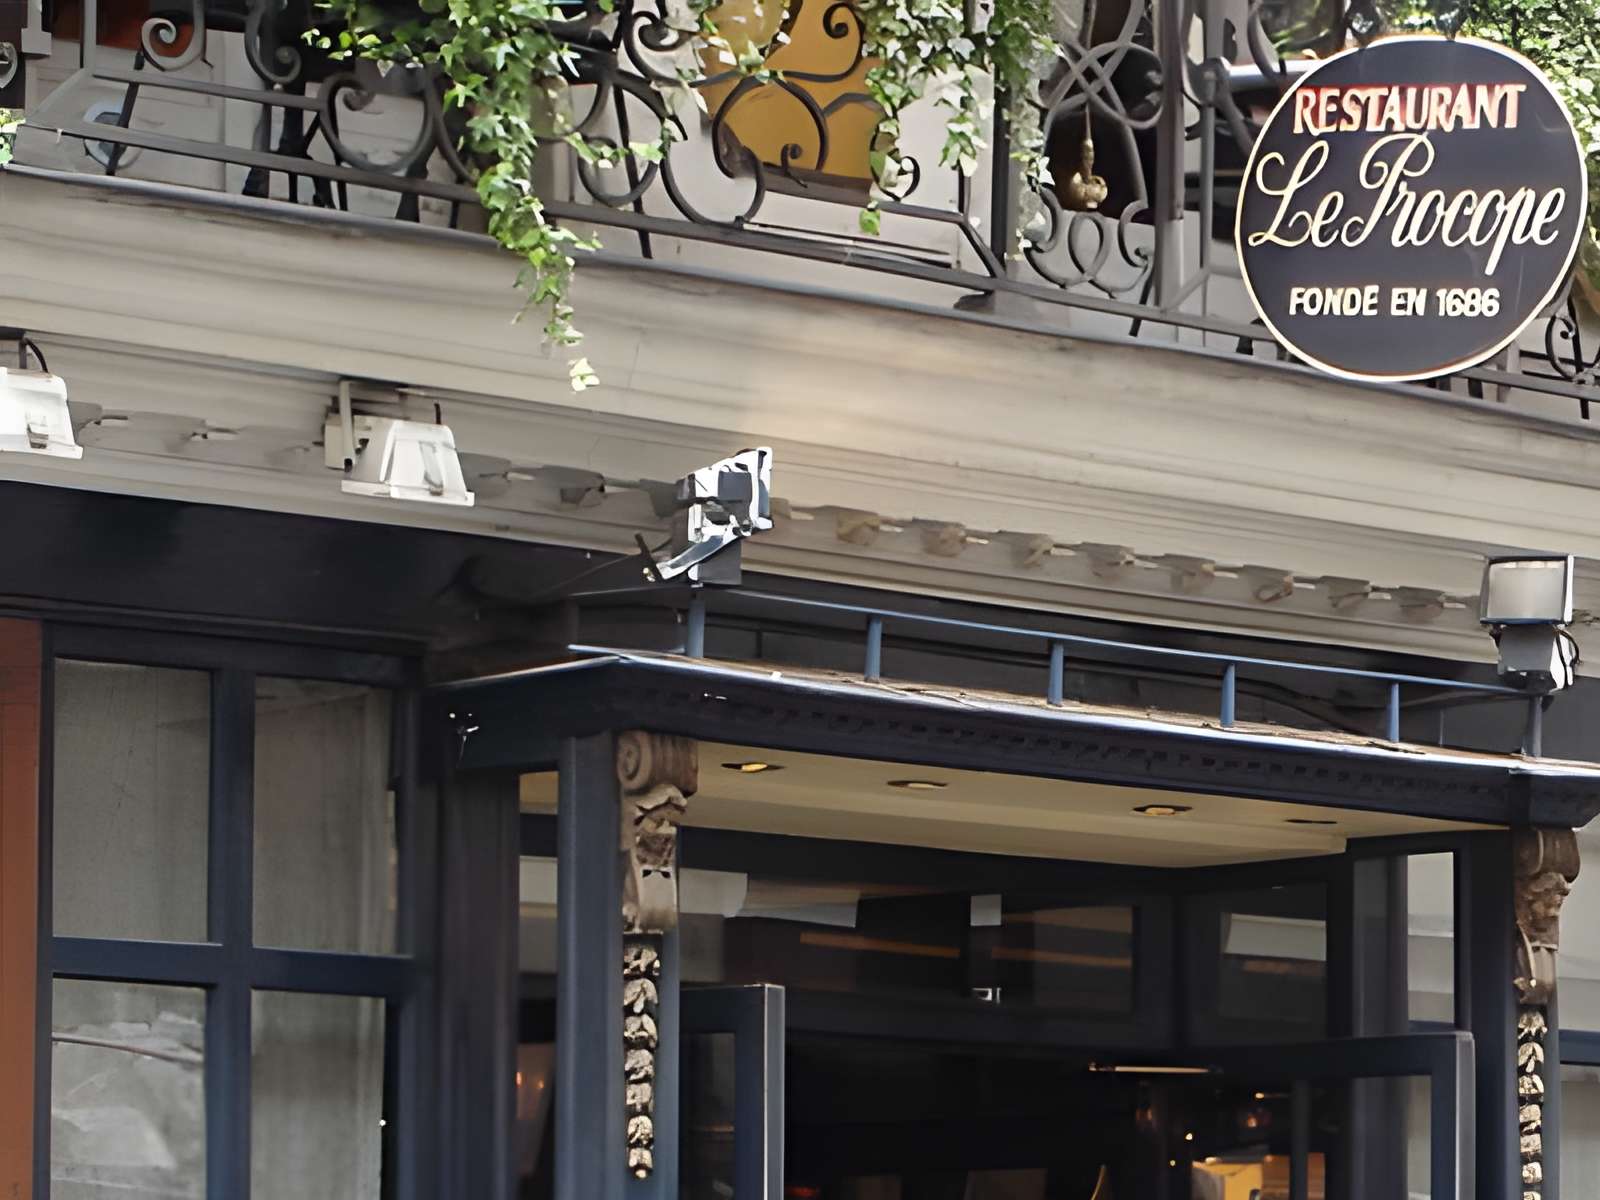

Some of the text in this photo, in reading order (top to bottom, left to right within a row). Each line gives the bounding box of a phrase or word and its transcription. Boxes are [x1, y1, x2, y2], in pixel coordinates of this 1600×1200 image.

[1292, 82, 1527, 135] RESTAURANT
[1248, 132, 1566, 276] Le Procope
[1288, 284, 1501, 318] FONDE EN 1686
